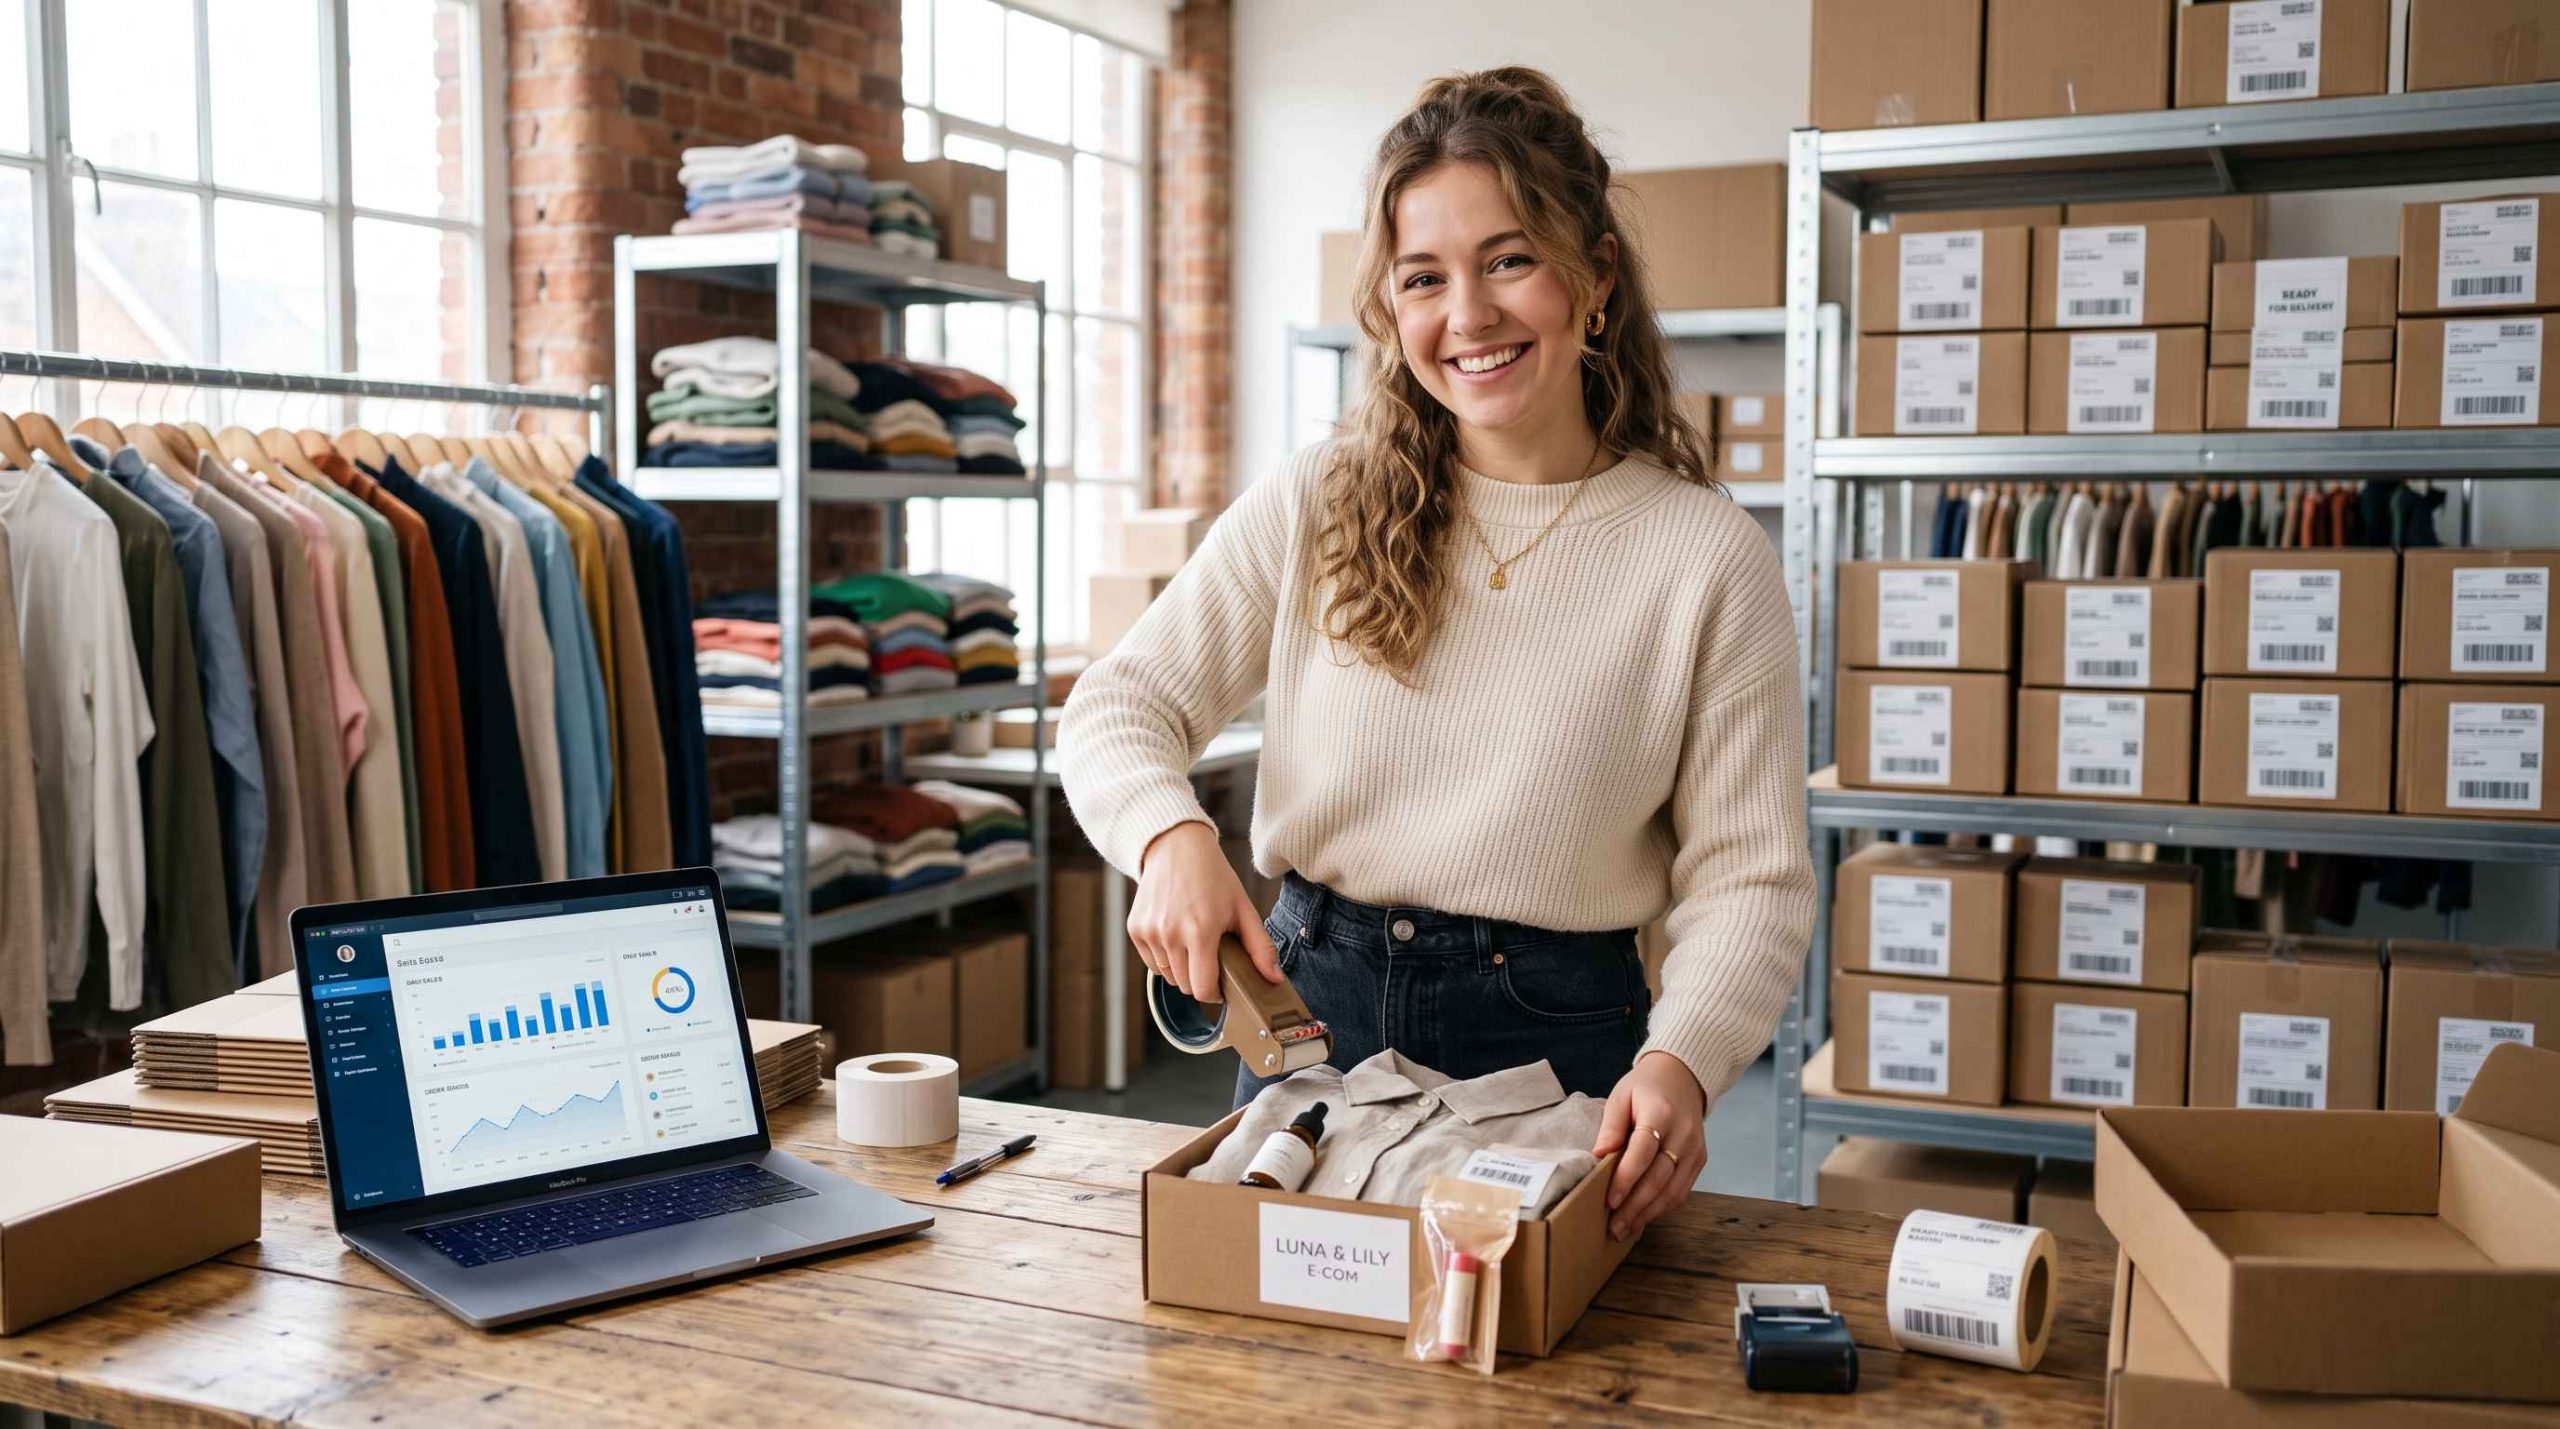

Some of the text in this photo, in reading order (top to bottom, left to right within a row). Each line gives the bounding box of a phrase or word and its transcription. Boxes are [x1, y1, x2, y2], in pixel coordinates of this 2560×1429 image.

[2281, 289, 2318, 300] READY
[2290, 301, 2334, 312] DELIVERY
[1276, 1236, 1390, 1267] LUNA & LILY
